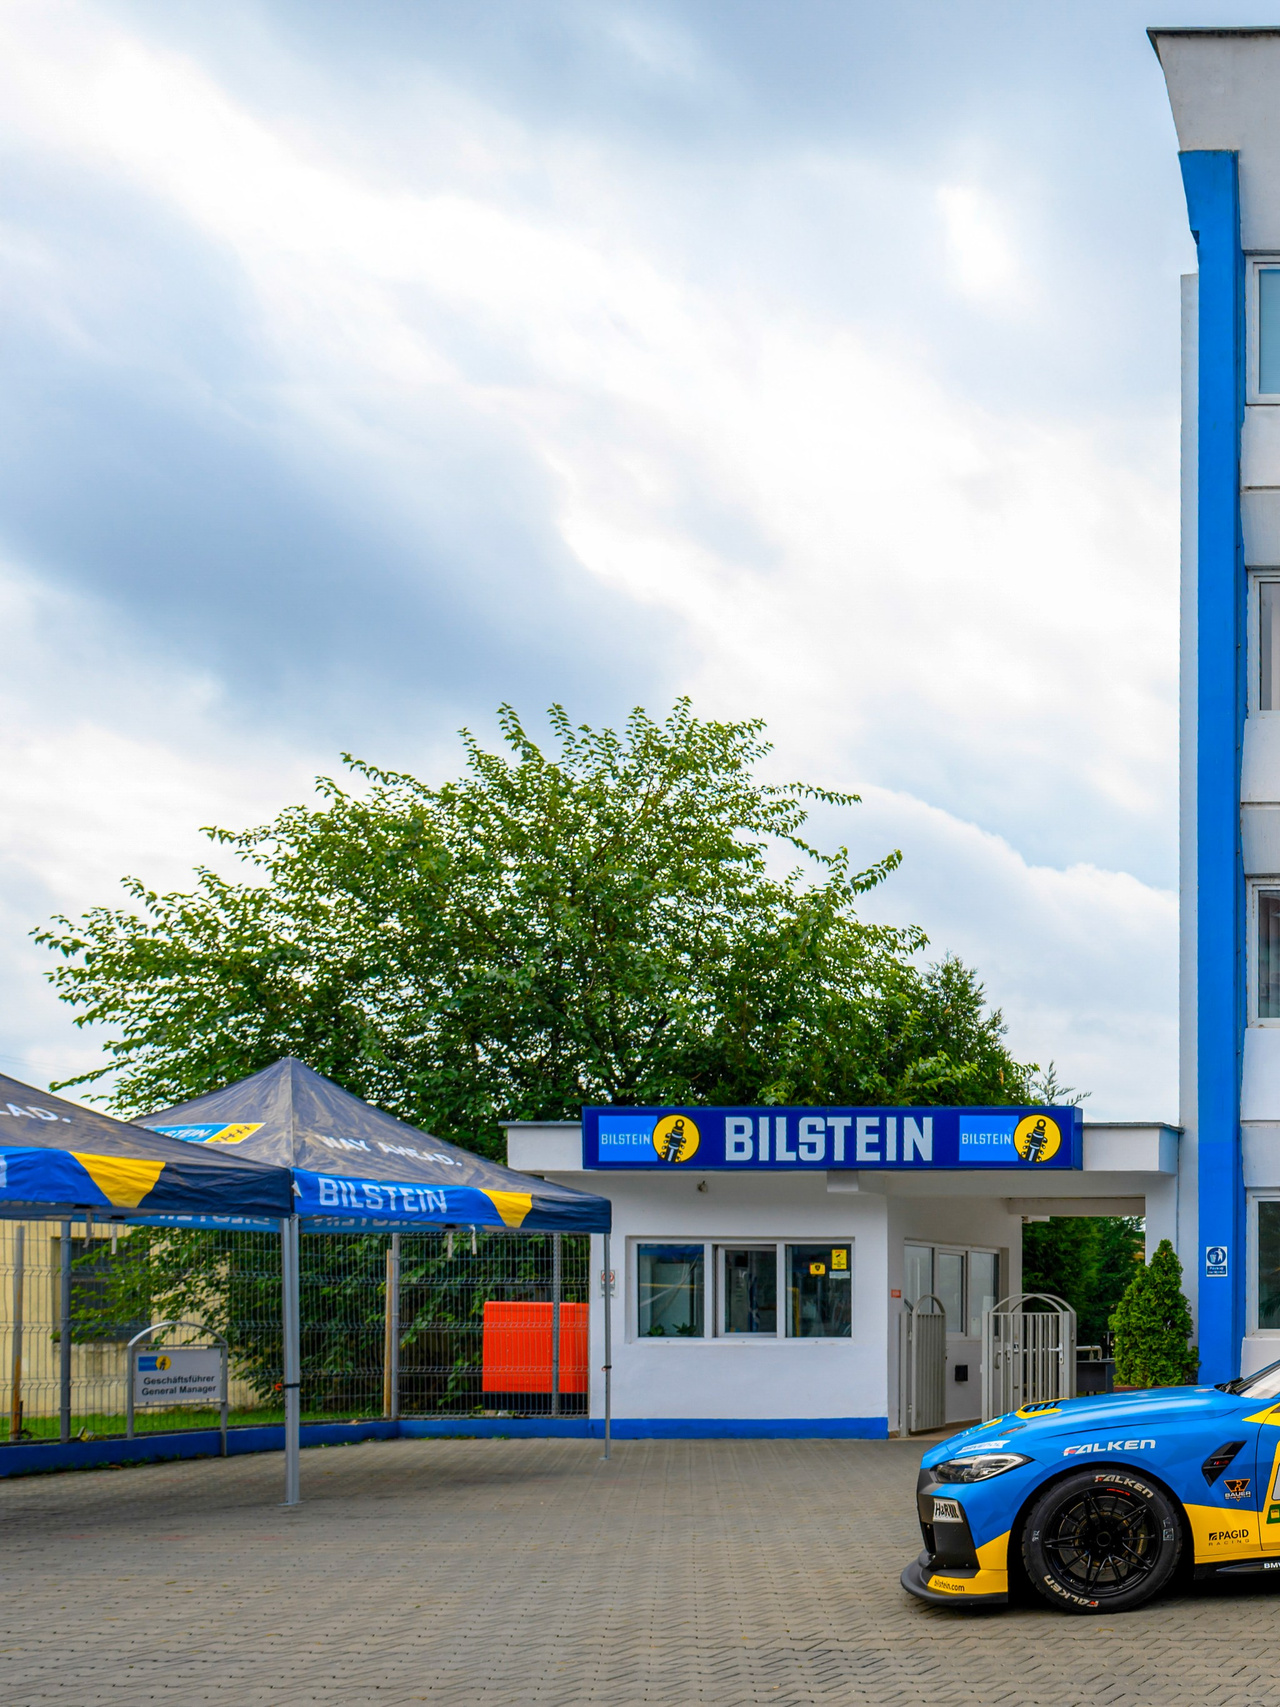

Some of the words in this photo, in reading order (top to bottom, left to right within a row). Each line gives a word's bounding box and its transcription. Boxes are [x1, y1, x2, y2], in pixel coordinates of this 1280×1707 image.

[314, 1134, 371, 1152] WAY
[601, 1133, 651, 1145] BILSTEIN
[725, 1116, 933, 1162] BILSTEIN
[961, 1133, 1012, 1145] BILSTEIN
[318, 1177, 448, 1214] BILSTEIN
[143, 1375, 215, 1385] Geschäftsführer
[141, 1386, 177, 1396] General
[179, 1385, 216, 1394] Manager
[1063, 1439, 1156, 1457] FALKEN
[1094, 1474, 1154, 1499] FALKEN
[1218, 1529, 1249, 1540] PAGID
[933, 1579, 965, 1592] bilstein.com
[1043, 1574, 1099, 1608] FALKEN
